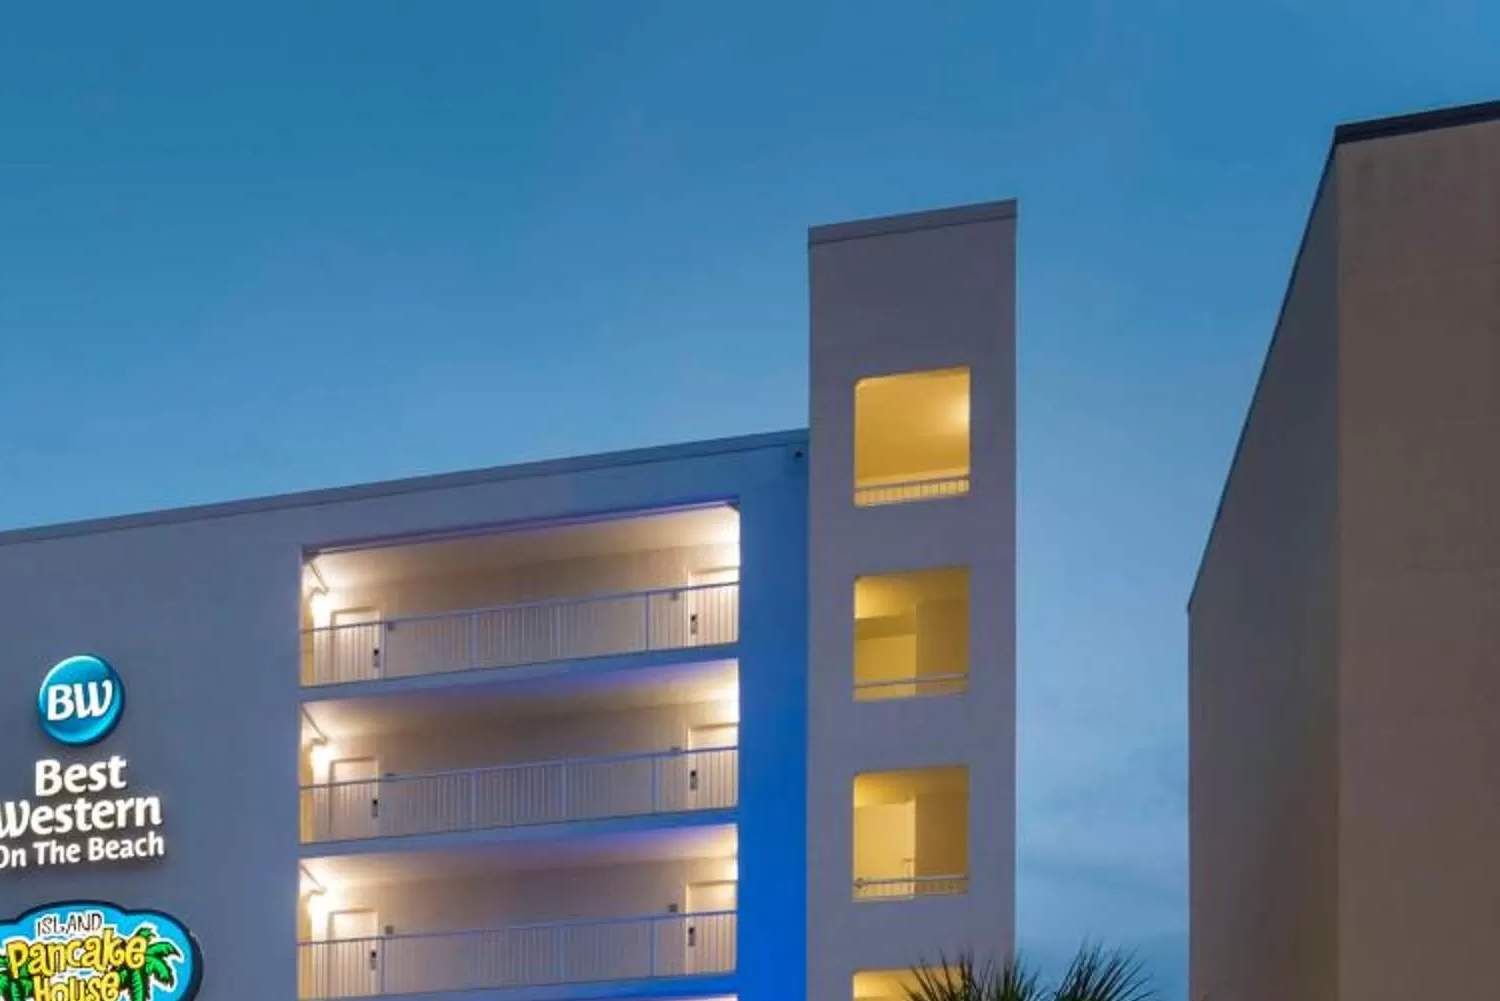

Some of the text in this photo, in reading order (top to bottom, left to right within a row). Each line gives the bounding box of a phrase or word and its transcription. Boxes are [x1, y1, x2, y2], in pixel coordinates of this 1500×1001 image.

[47, 679, 113, 721] BW
[35, 755, 127, 797] Best
[33, 839, 81, 865] The
[88, 831, 165, 861] Beach
[37, 912, 103, 937] ISLAND
[6, 928, 148, 978] Pancake
